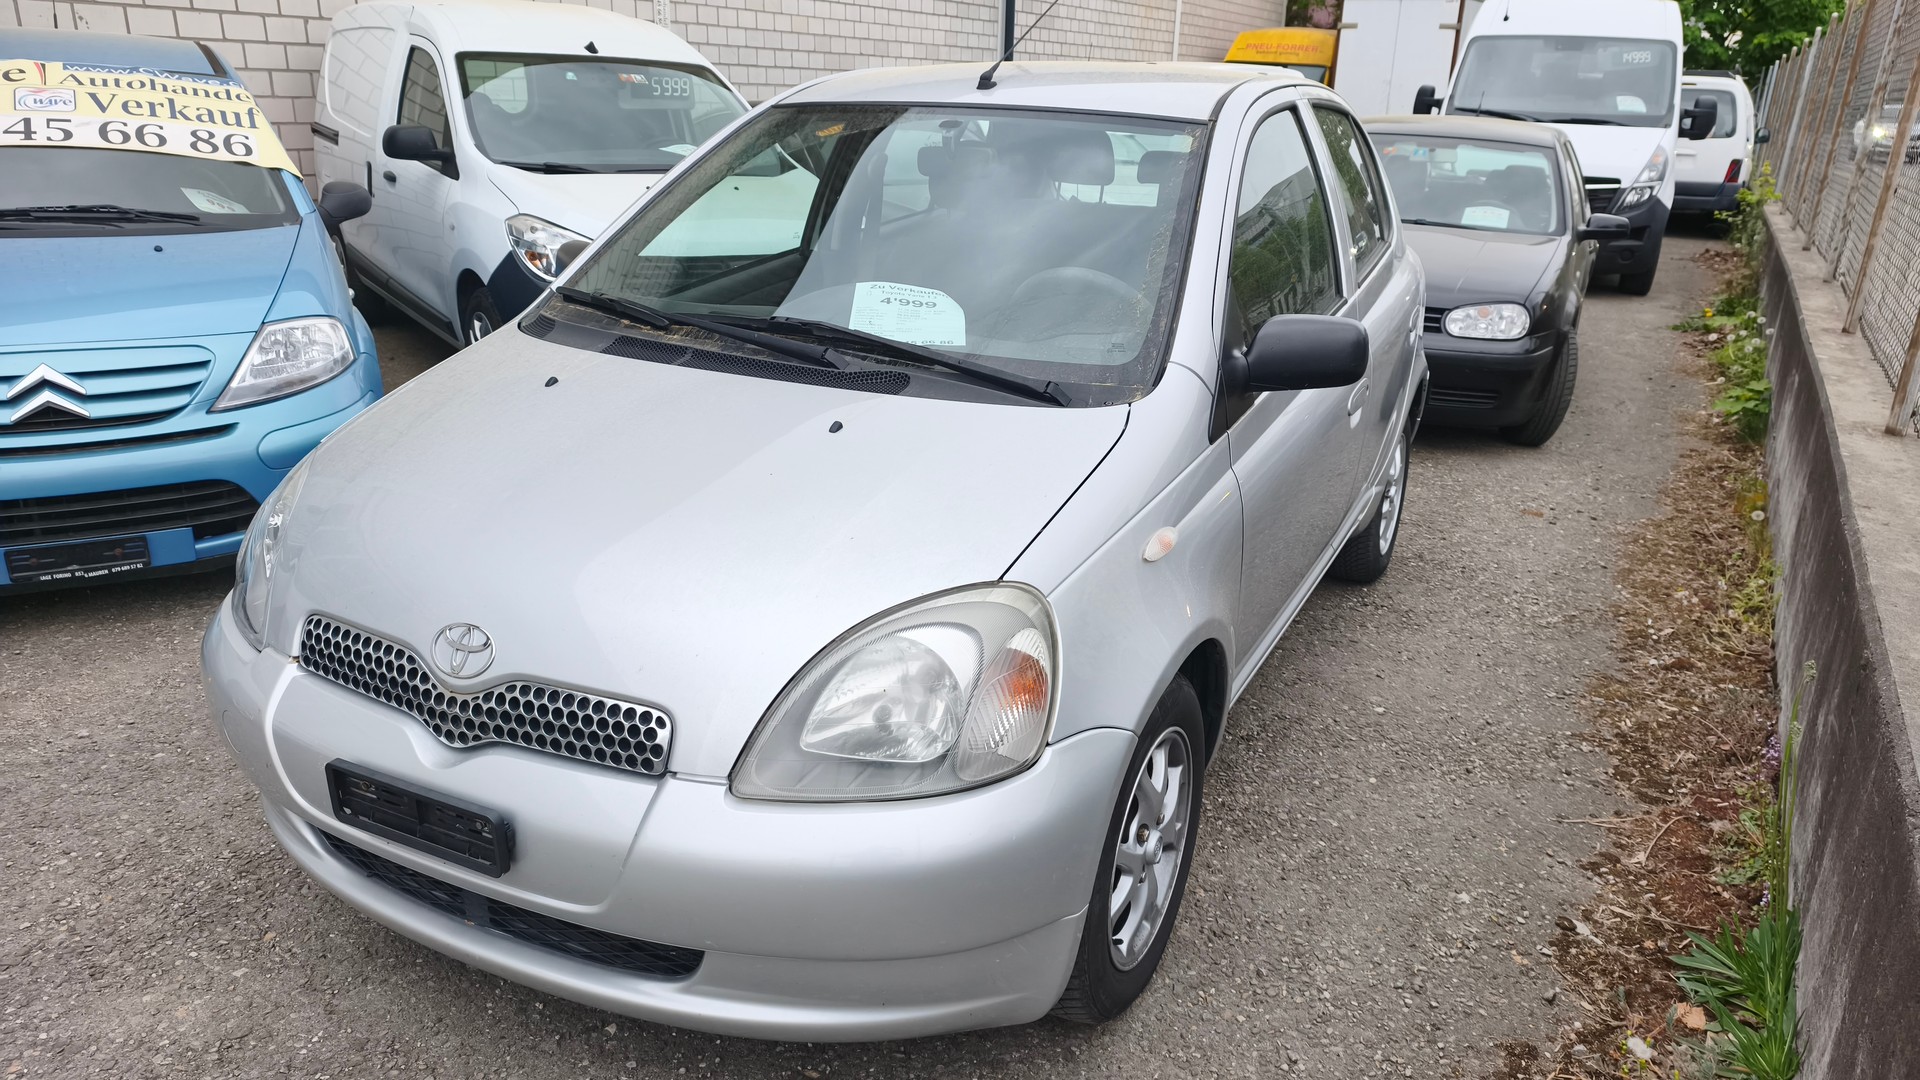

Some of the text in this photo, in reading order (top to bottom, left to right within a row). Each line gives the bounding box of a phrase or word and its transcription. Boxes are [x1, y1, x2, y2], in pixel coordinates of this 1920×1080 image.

[84, 91, 261, 129] Verkauf
[2, 117, 254, 157] 45 66 86
[879, 296, 938, 309] 4'999
